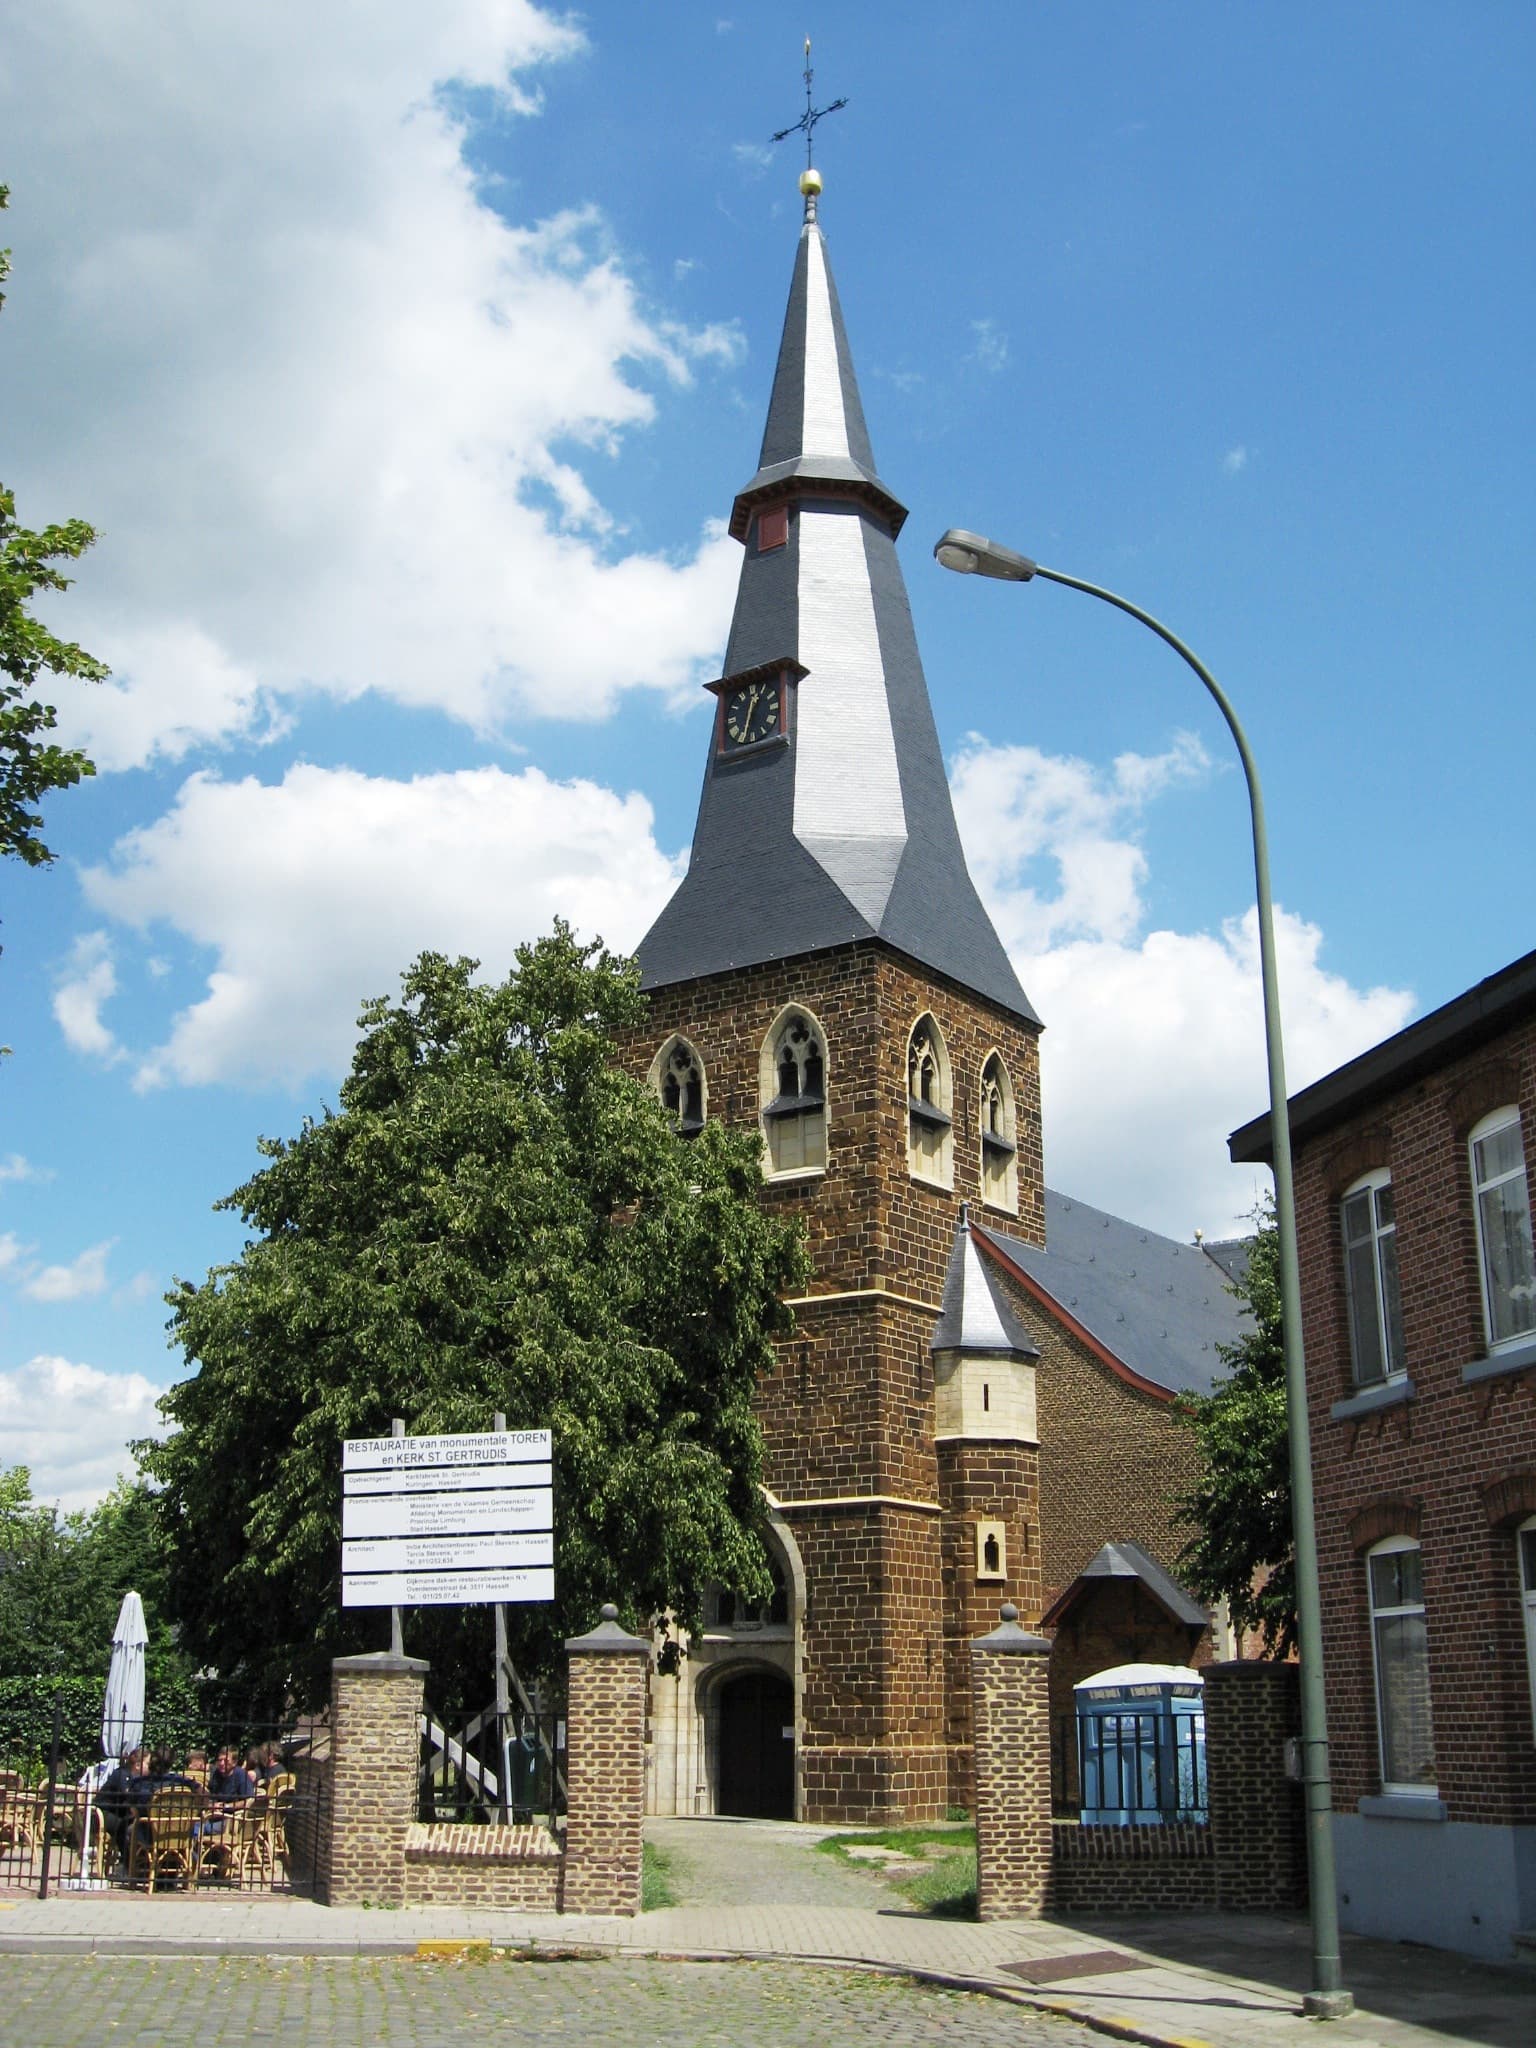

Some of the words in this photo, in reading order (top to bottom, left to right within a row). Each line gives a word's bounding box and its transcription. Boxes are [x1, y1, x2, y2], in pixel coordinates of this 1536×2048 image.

[347, 1439, 417, 1453] RESTAURATIE
[419, 1440, 437, 1449] van
[440, 1435, 508, 1448] monumentale
[510, 1432, 547, 1445] TOREN
[382, 1456, 394, 1465] en
[396, 1453, 425, 1464] KERK
[428, 1452, 444, 1463] ST.
[445, 1448, 508, 1462] GERTRUDIS
